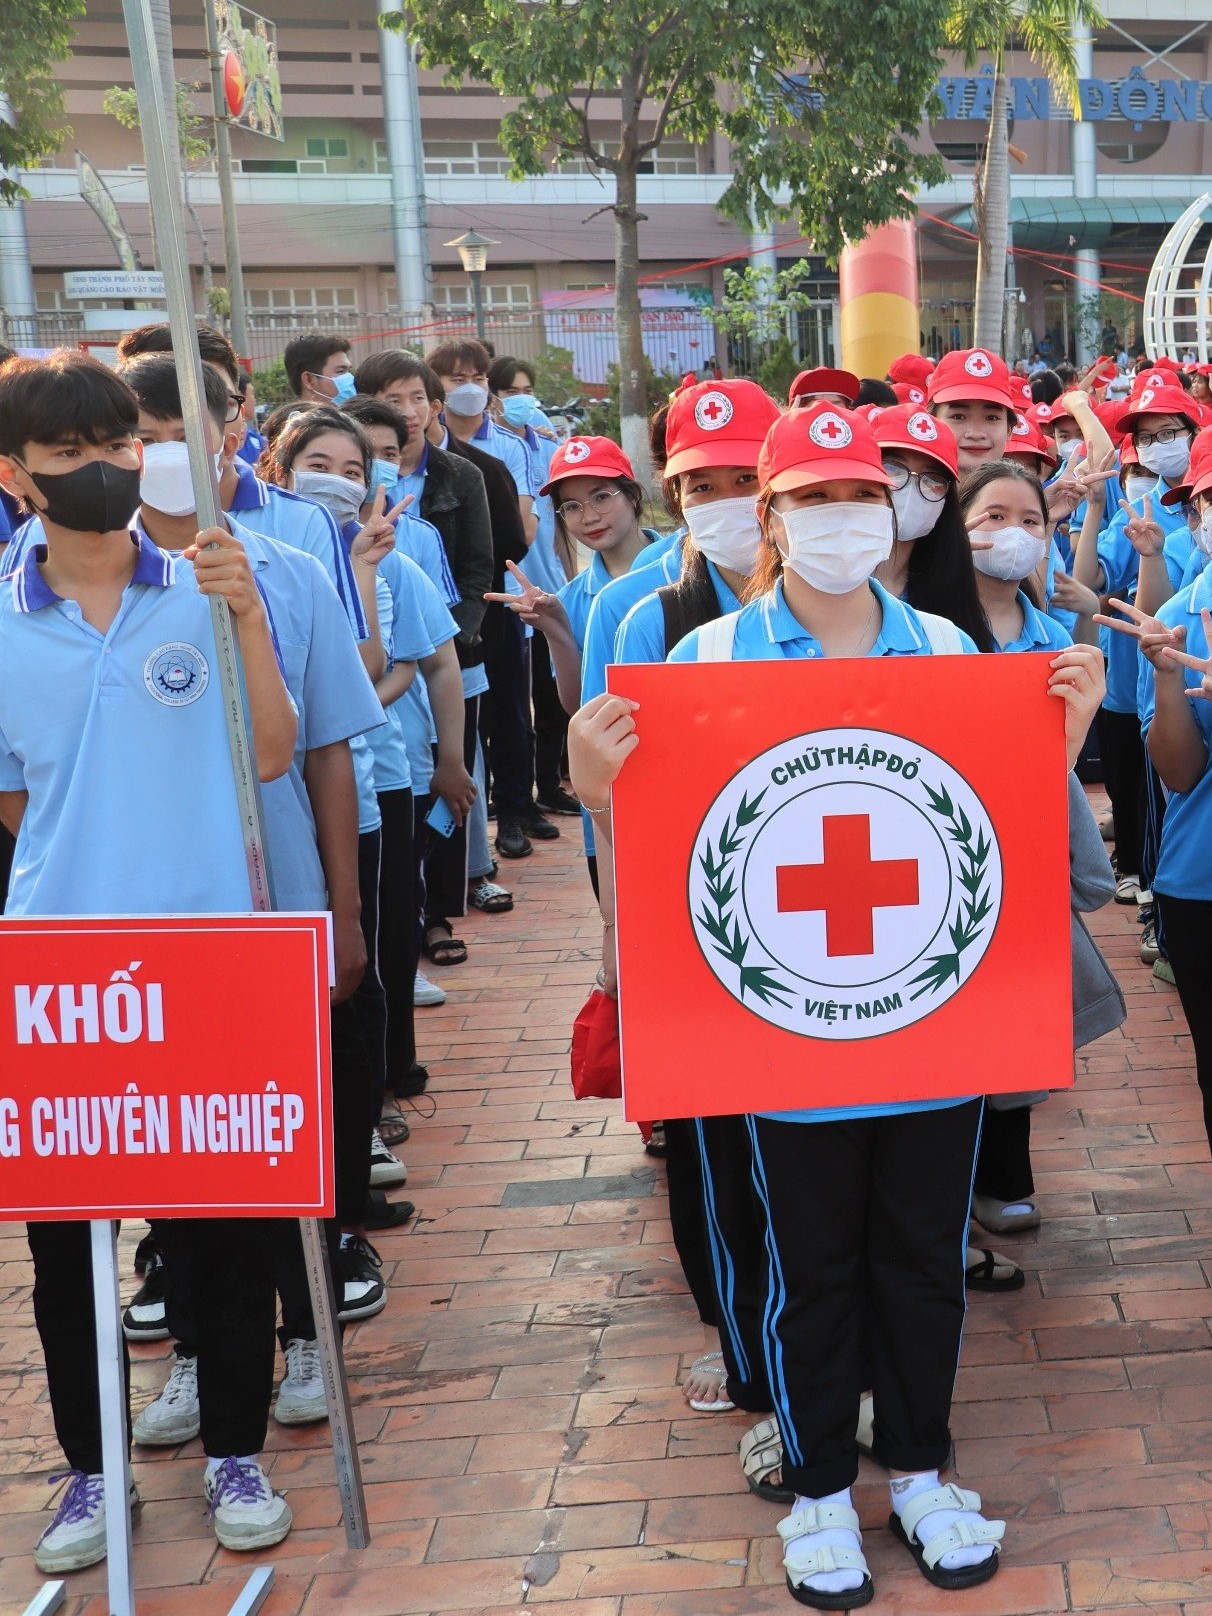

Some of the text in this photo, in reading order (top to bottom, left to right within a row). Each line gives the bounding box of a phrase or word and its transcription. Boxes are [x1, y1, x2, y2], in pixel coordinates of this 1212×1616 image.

[14, 961, 165, 1045] KHỐI
[804, 992, 903, 1026] VIỆT NAM
[31, 1082, 171, 1156] CHUYÊN
[180, 1080, 305, 1167] NGHIỆP
